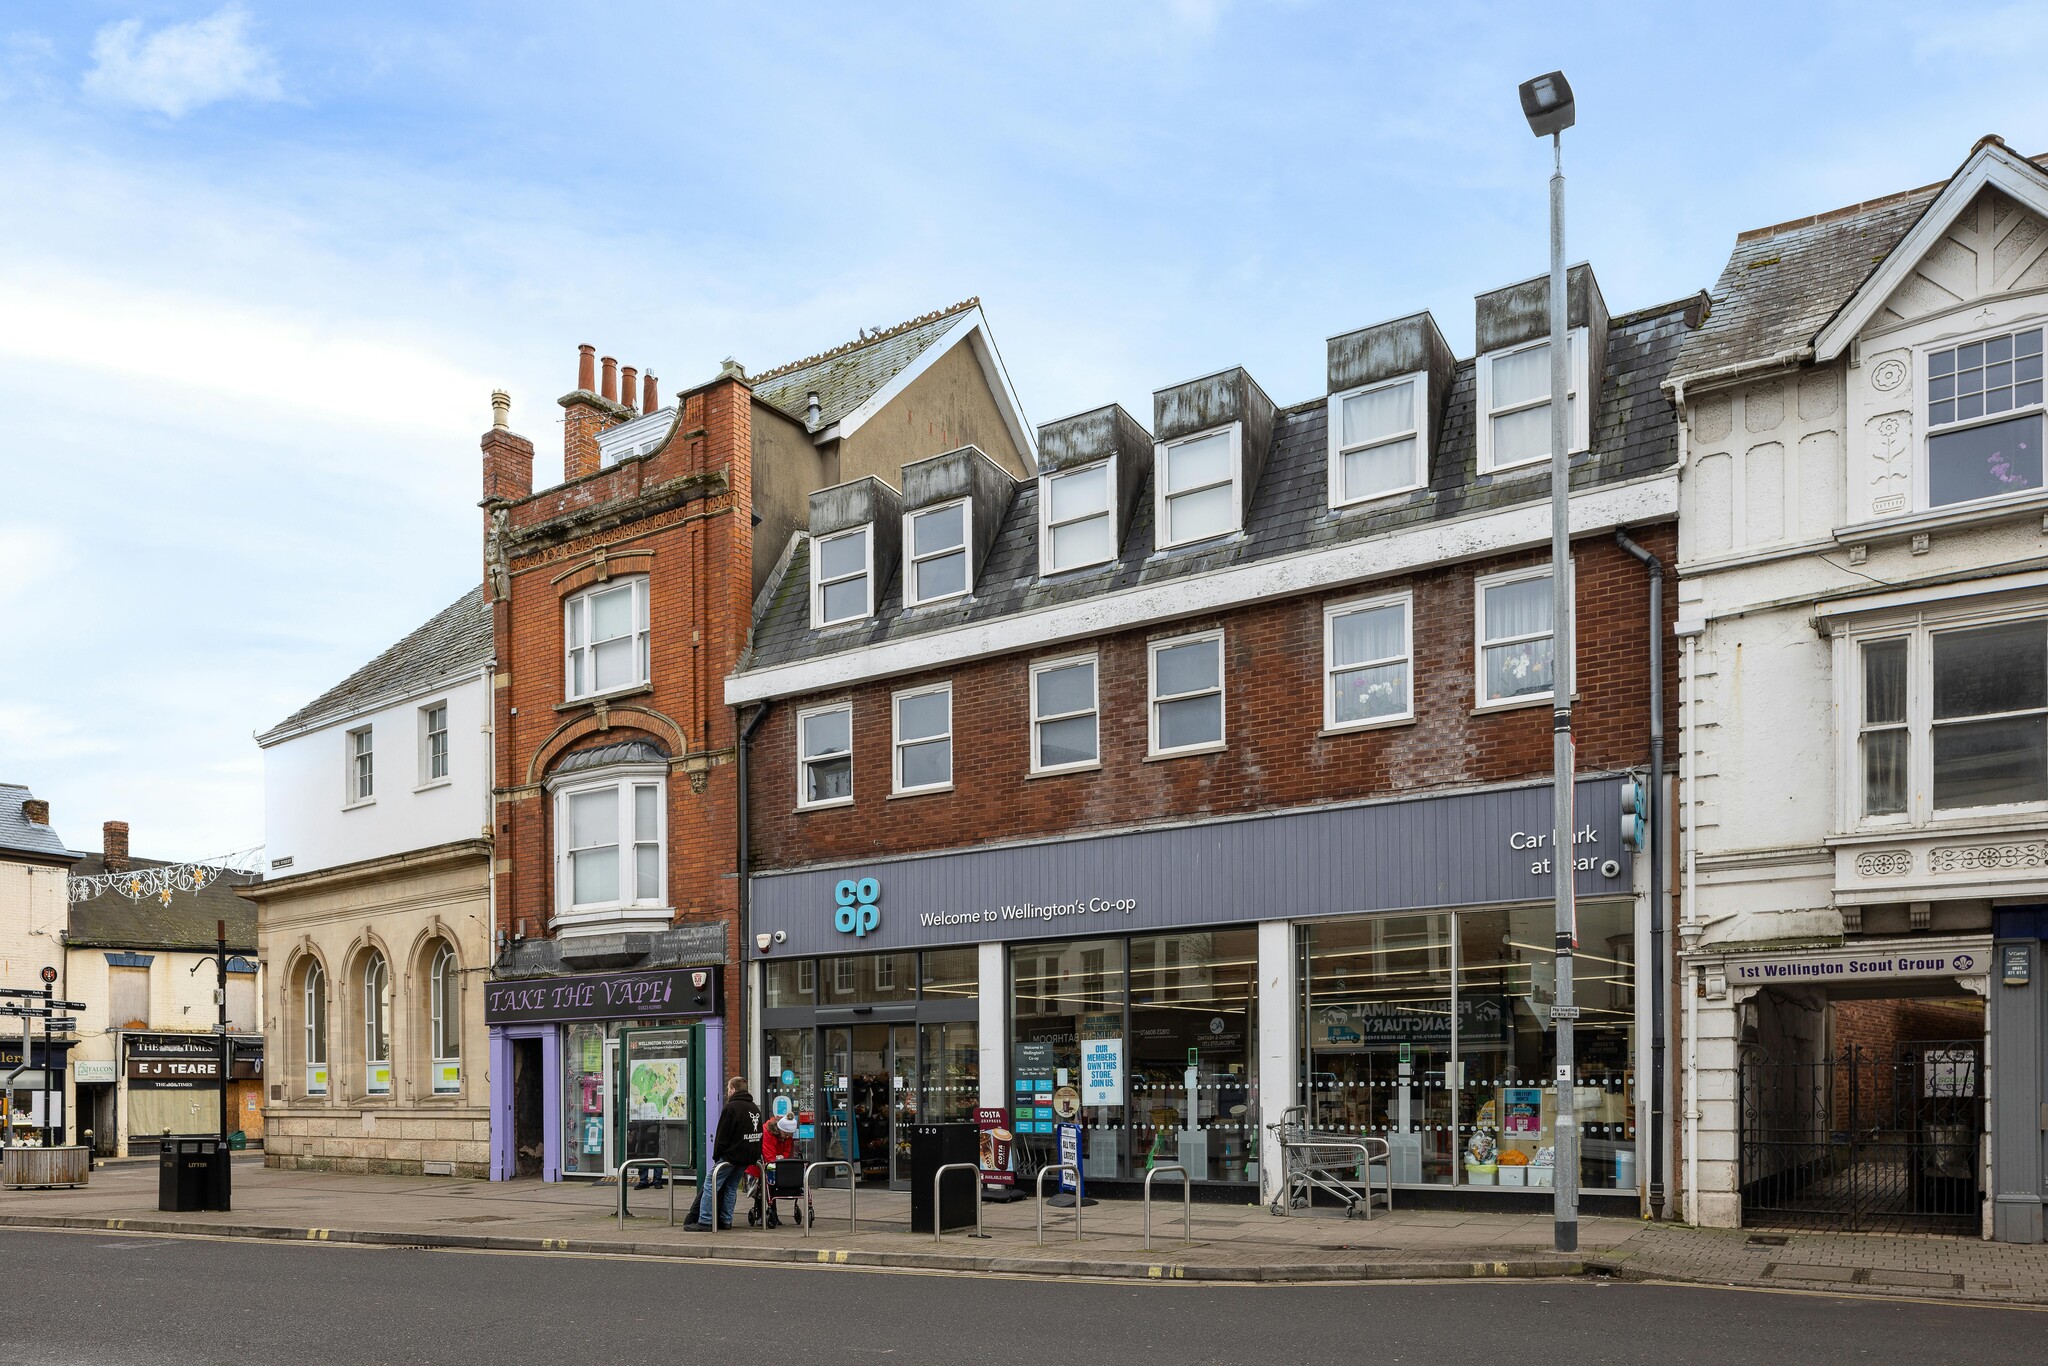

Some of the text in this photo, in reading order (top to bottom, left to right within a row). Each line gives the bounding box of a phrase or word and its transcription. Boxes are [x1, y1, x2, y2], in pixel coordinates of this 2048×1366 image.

[1510, 831, 1547, 850] Car
[1531, 858, 1551, 875] at
[920, 897, 1136, 927] Welcome to Wellington's Co-op
[1738, 957, 1945, 978] 1st Wellington Scout Group
[489, 980, 664, 1012] TAKE THE VAPE
[137, 1043, 160, 1052] THE
[182, 1043, 213, 1052] TIMES
[1087, 1053, 1117, 1061] MEMBERS
[138, 1064, 216, 1074] E J TEARE
[1105, 1079, 1115, 1087] US.
